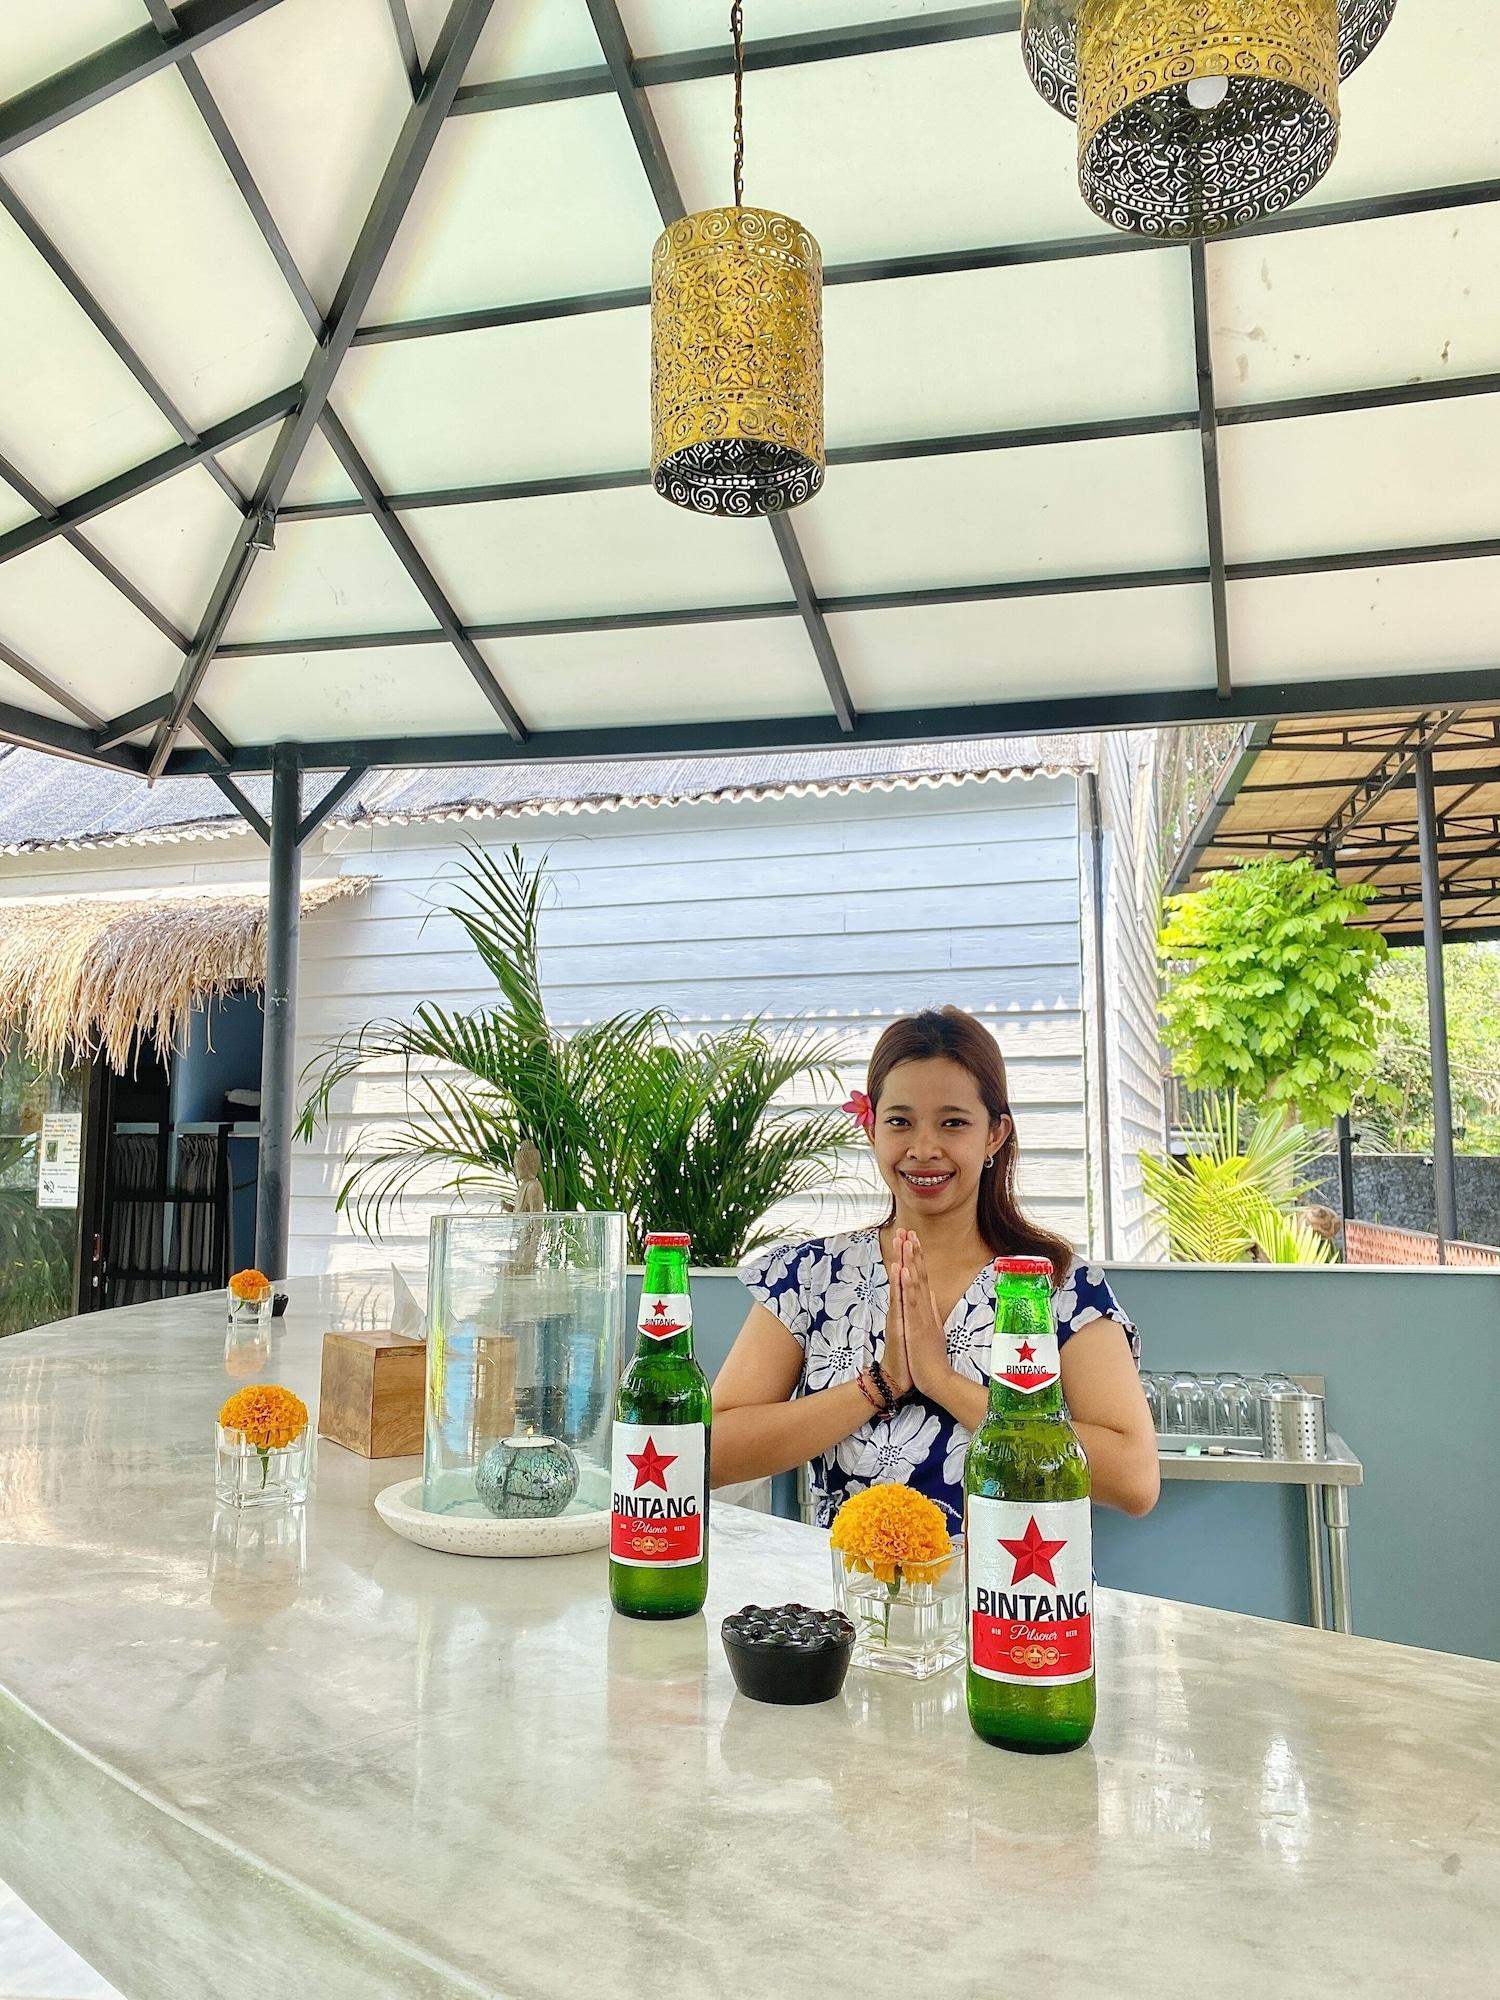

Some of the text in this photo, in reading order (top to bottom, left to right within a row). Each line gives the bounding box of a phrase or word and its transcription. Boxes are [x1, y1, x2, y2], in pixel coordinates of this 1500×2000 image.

[645, 1318, 676, 1326] BINTANG
[1006, 1365, 1047, 1375] BINTANG
[613, 1492, 697, 1519] BINTANG
[631, 1520, 668, 1534] Pilsener
[976, 1586, 1088, 1622] BINTANG
[1009, 1624, 1058, 1641] Pilsener
[1065, 1629, 1078, 1638] BEER
